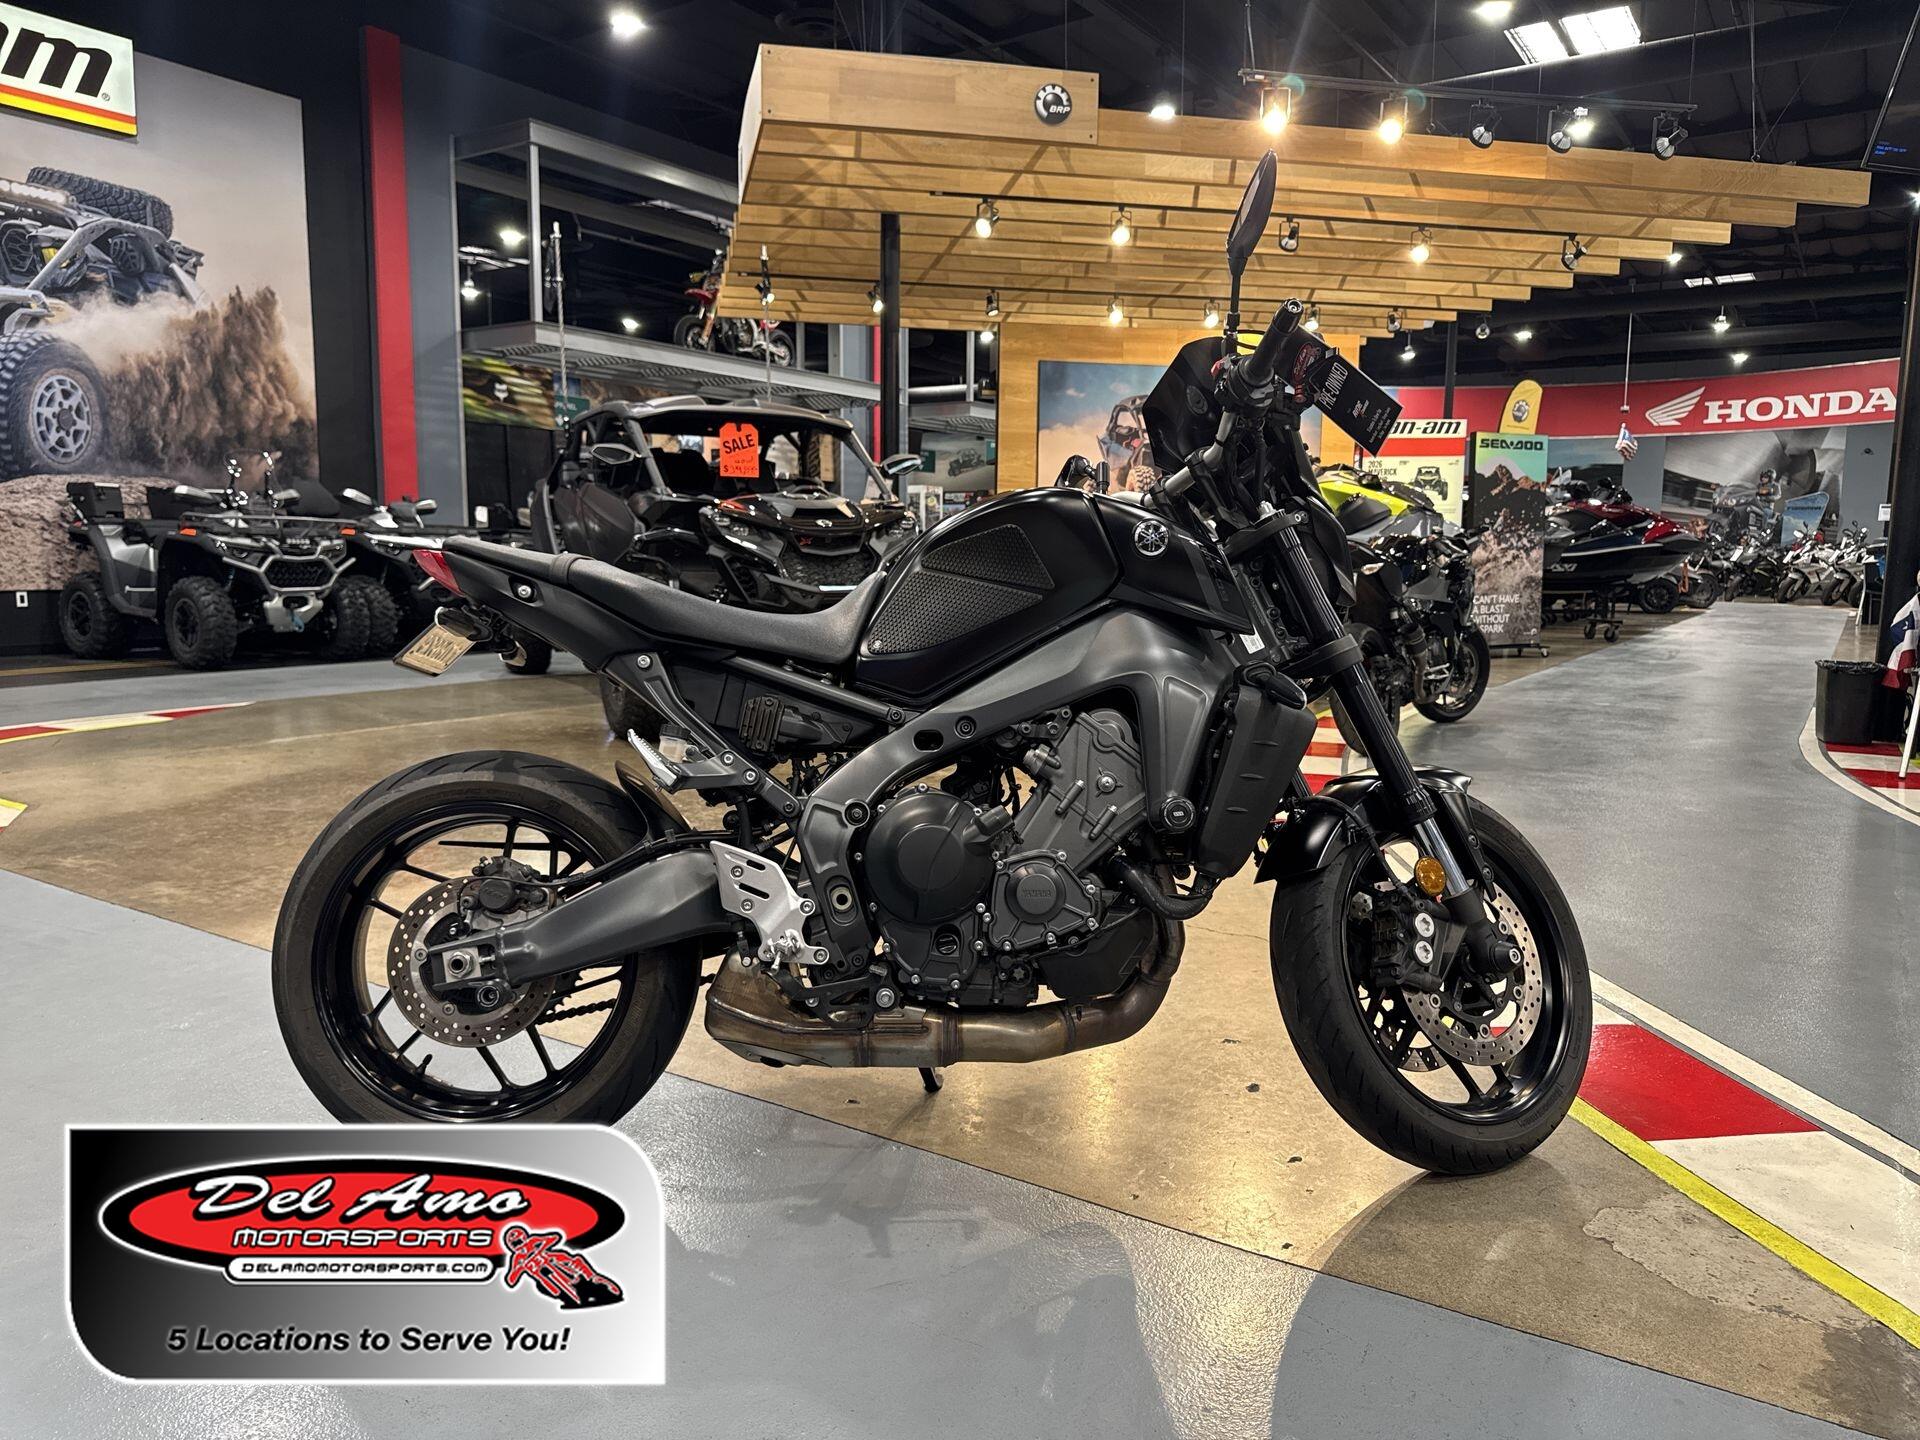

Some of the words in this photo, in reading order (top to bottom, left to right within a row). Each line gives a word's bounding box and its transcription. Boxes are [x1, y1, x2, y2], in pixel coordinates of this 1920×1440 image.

[1049, 105, 1071, 114] BRP
[1319, 362, 1348, 410] PRE-OWNED
[1703, 387, 1897, 424] HONDA
[723, 434, 755, 454] SALE
[1473, 595, 1497, 604] CAN'T
[1499, 594, 1520, 603] HAVE
[1472, 605, 1479, 614] A
[1480, 604, 1505, 614] BLAST
[1480, 624, 1504, 633] SPARK
